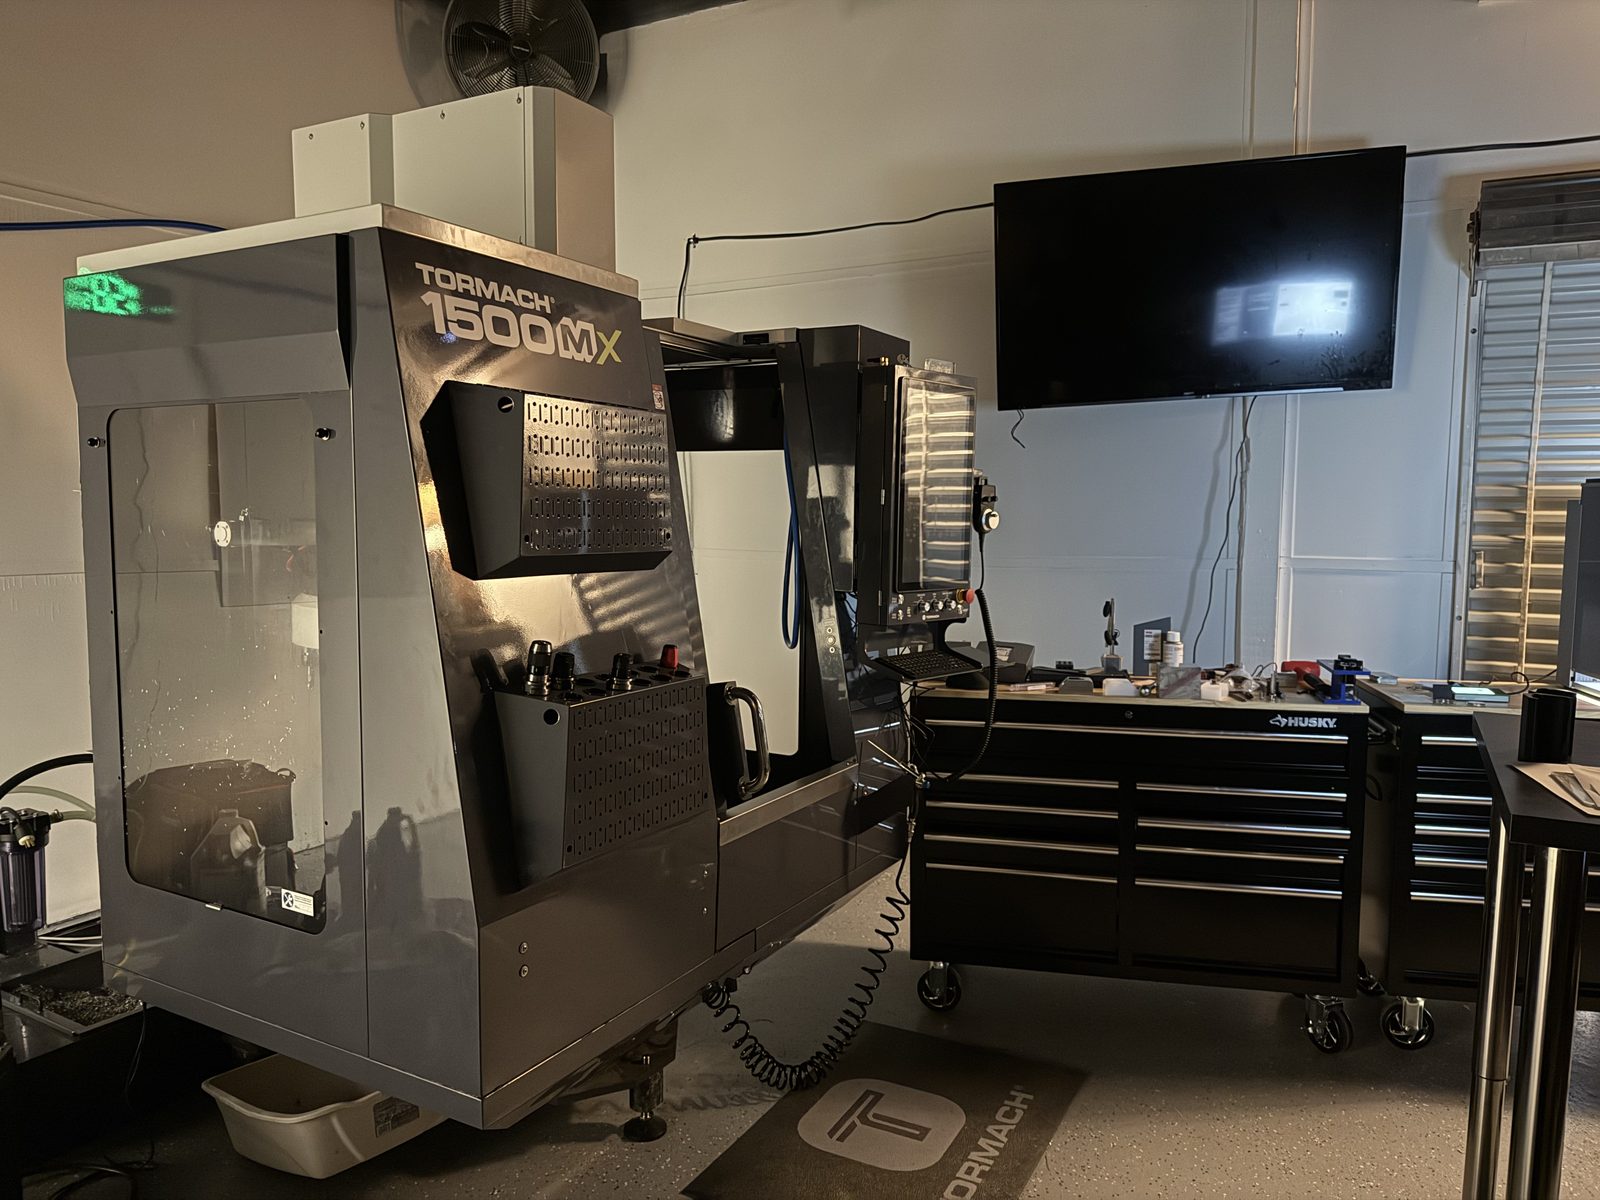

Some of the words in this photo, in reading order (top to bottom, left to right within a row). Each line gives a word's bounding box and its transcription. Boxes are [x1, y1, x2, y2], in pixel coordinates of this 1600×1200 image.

[414, 262, 552, 314] TORMACH
[1287, 716, 1337, 728] HUSKY
[940, 1089, 1035, 1200] ORMACH
